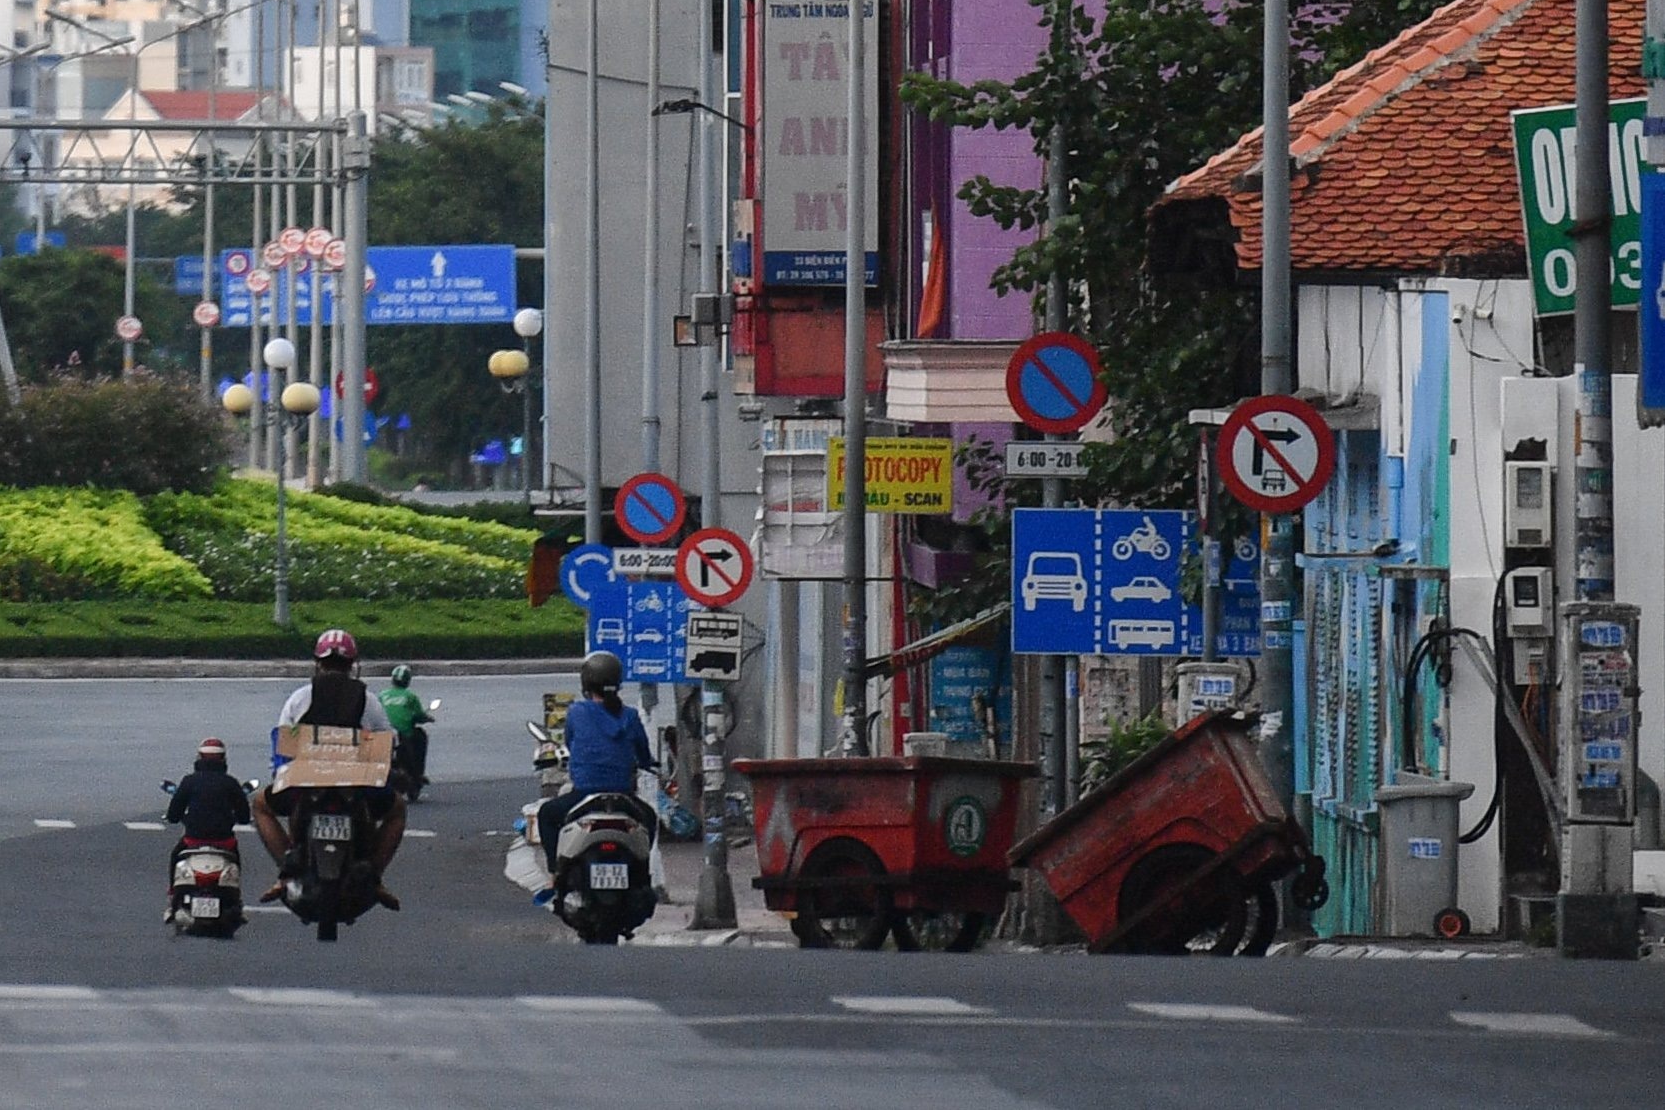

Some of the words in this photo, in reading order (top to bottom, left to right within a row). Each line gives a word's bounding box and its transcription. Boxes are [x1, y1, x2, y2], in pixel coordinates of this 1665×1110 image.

[770, 3, 802, 19] TRUNG
[803, 1, 824, 19] TÂM
[825, 3, 850, 20] NGOẠ
[1017, 451, 1087, 468] 6:00-20:0
[837, 456, 942, 483] POTOCOPY
[904, 492, 943, 506] SCAN
